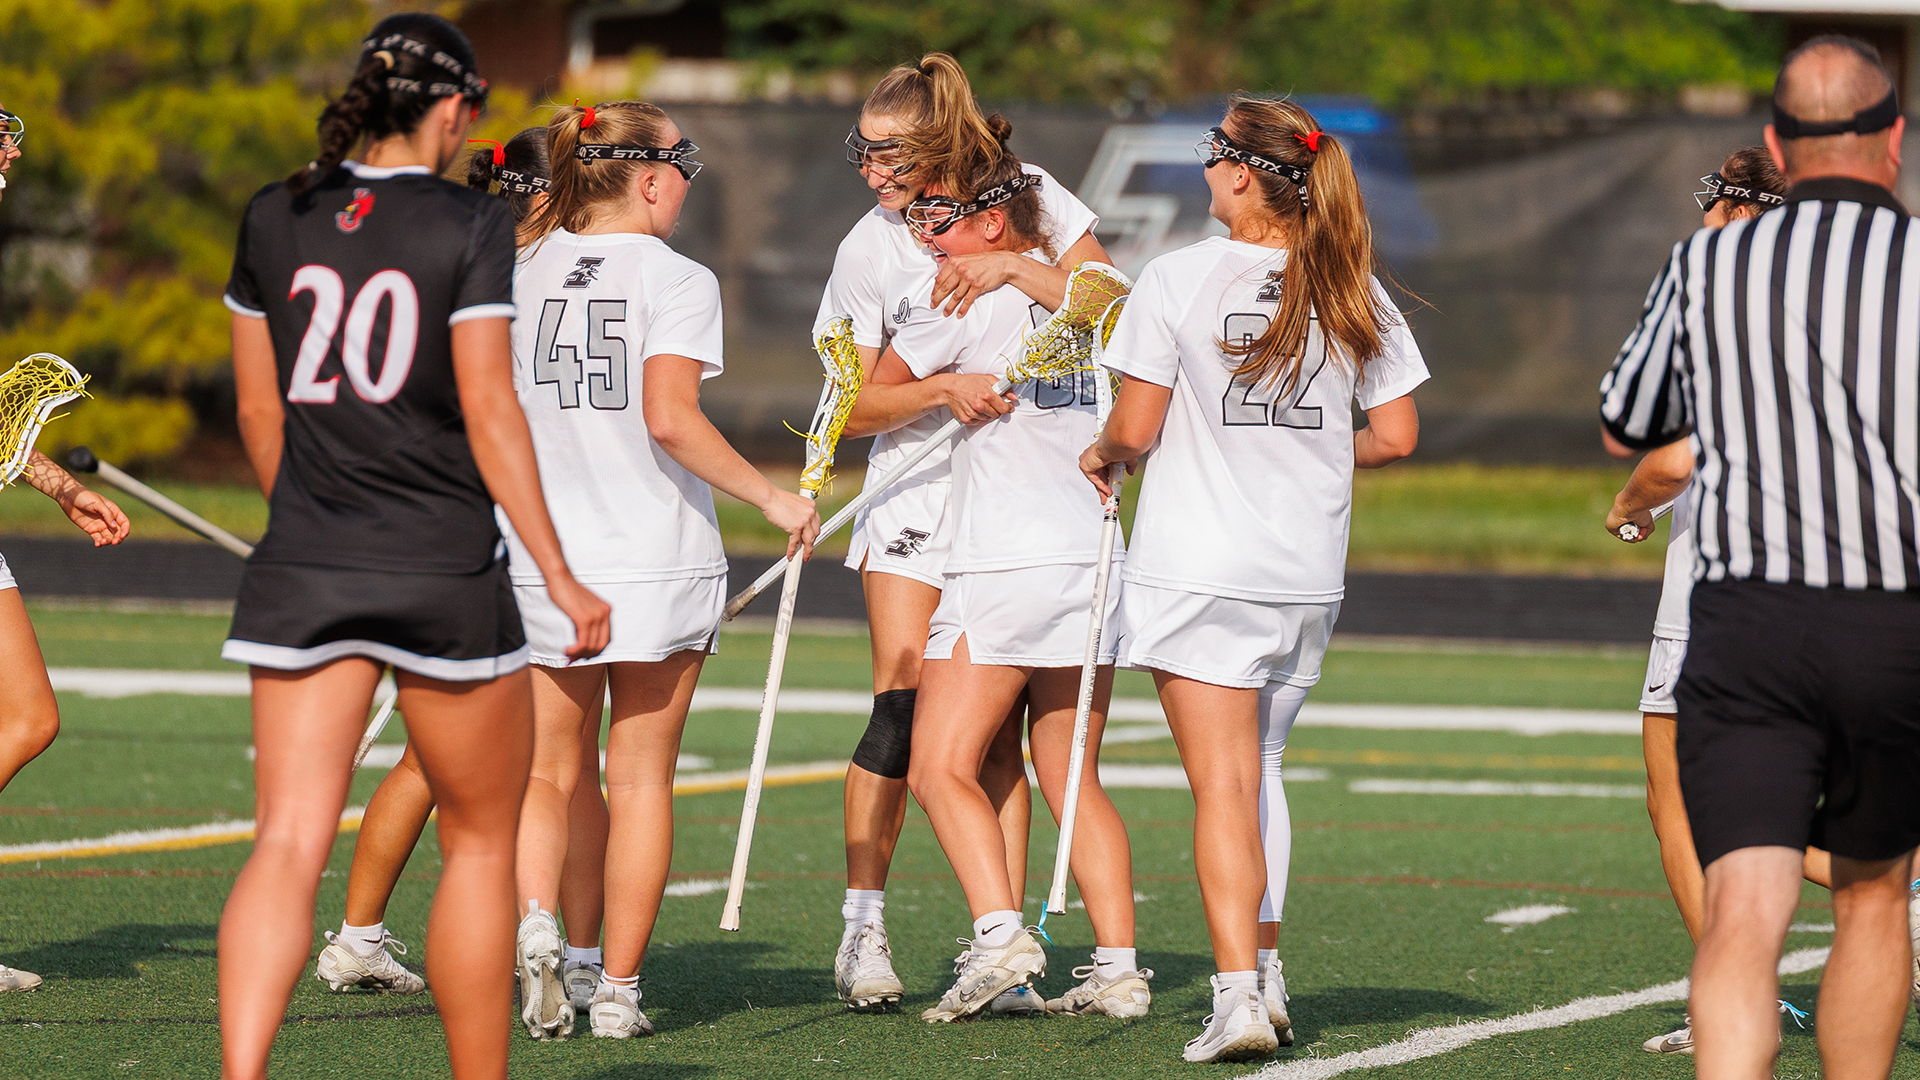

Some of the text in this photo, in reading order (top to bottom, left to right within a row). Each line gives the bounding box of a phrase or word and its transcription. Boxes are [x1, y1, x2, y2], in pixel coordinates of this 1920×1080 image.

[612, 150, 648, 159] STX
[657, 151, 682, 160] ST
[1222, 146, 1281, 173] TX STX
[502, 170, 552, 188] STX ST
[1723, 186, 1751, 199] STX
[287, 263, 420, 405] 20
[533, 299, 628, 411] 45
[1222, 312, 1327, 429] 22
[775, 588, 796, 639] STX
